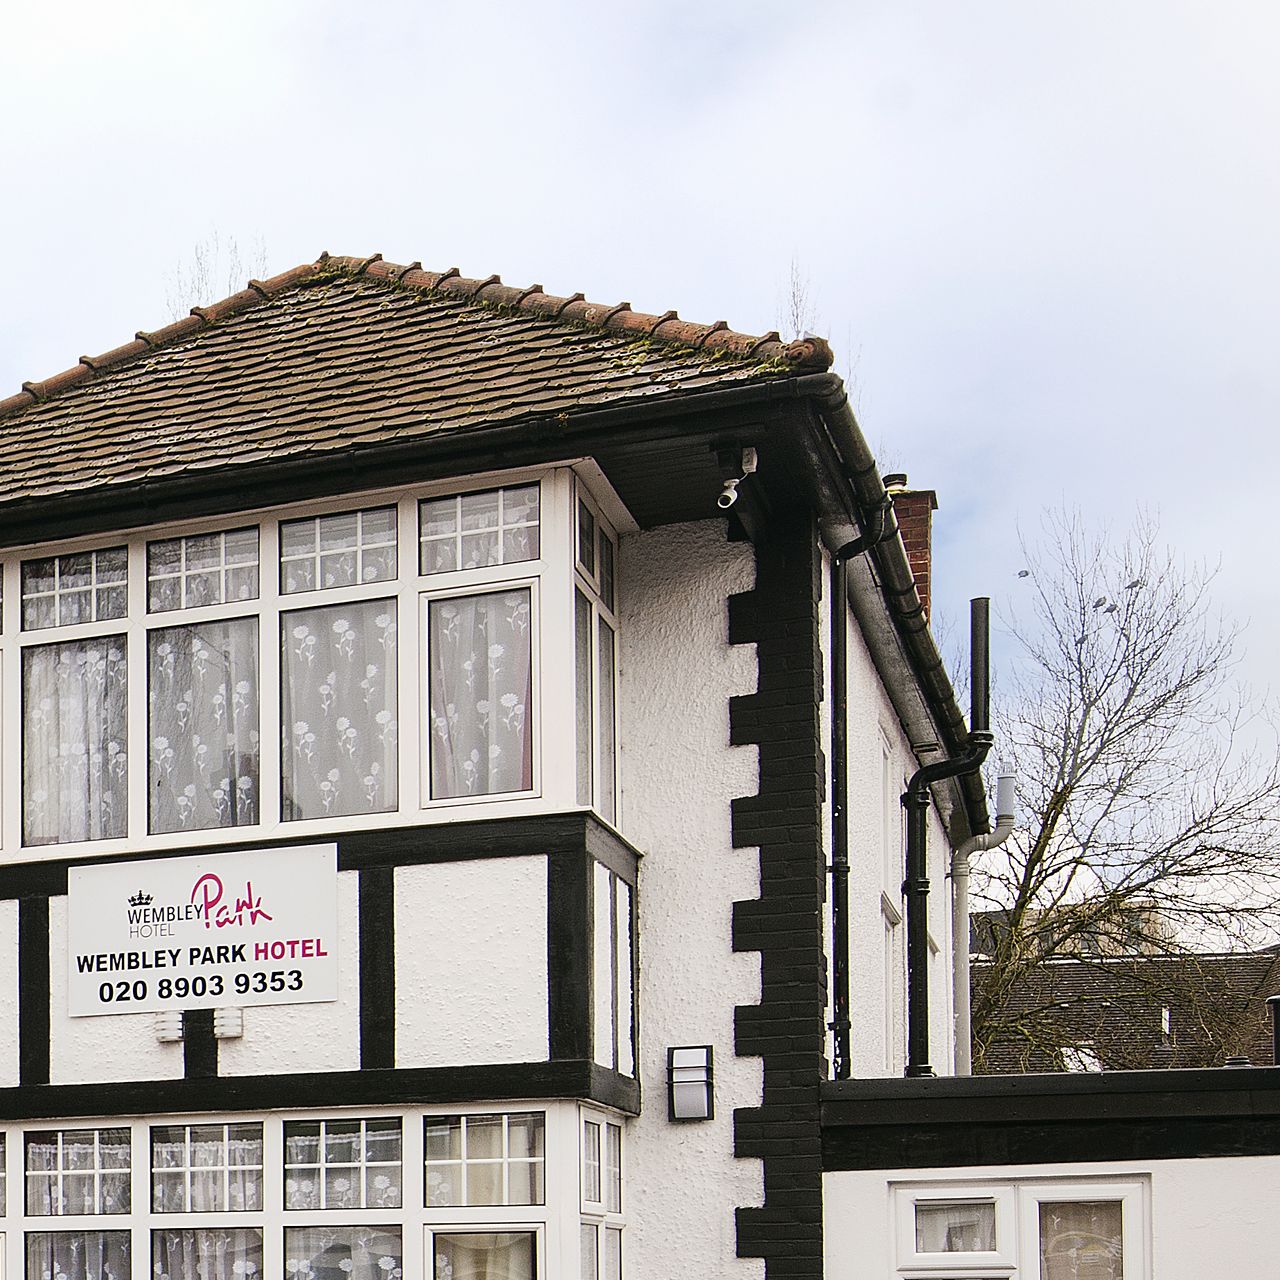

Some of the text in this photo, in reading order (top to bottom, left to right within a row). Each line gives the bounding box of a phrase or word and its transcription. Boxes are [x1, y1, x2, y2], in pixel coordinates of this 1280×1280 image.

[127, 873, 273, 929] WEMBLEY Park
[129, 923, 175, 938] HOTEL
[76, 938, 328, 973] WEMBLEY PARK HOTEL
[99, 969, 304, 1003] 020 8903 9353
